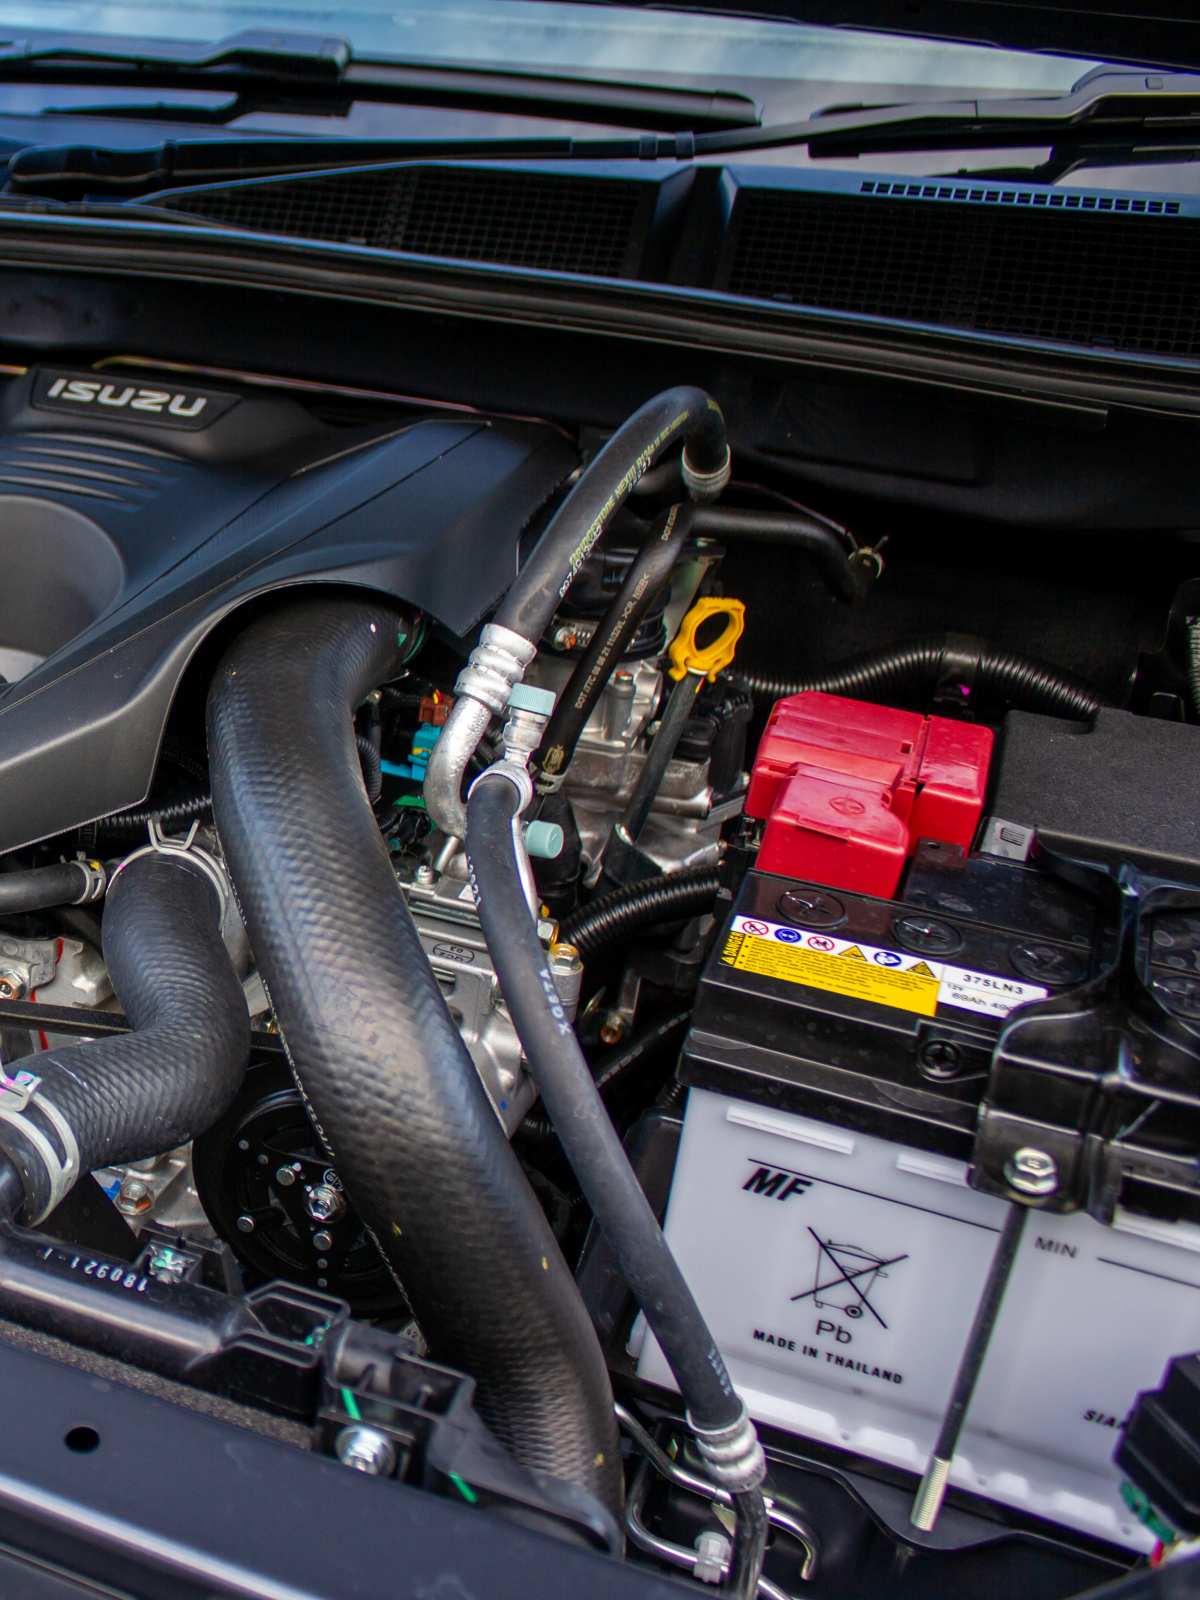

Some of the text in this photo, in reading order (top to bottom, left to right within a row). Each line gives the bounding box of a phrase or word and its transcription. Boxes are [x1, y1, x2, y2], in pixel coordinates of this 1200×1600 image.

[48, 378, 207, 416] ISUZU
[722, 930, 744, 957] DANGER
[962, 973, 1023, 995] 375LN3
[742, 1166, 815, 1201] MF
[1034, 1236, 1078, 1259] MIN
[815, 1319, 852, 1345] Pb
[753, 1328, 903, 1385] MADE IN THAILAND
[1083, 1408, 1126, 1431] SIA
